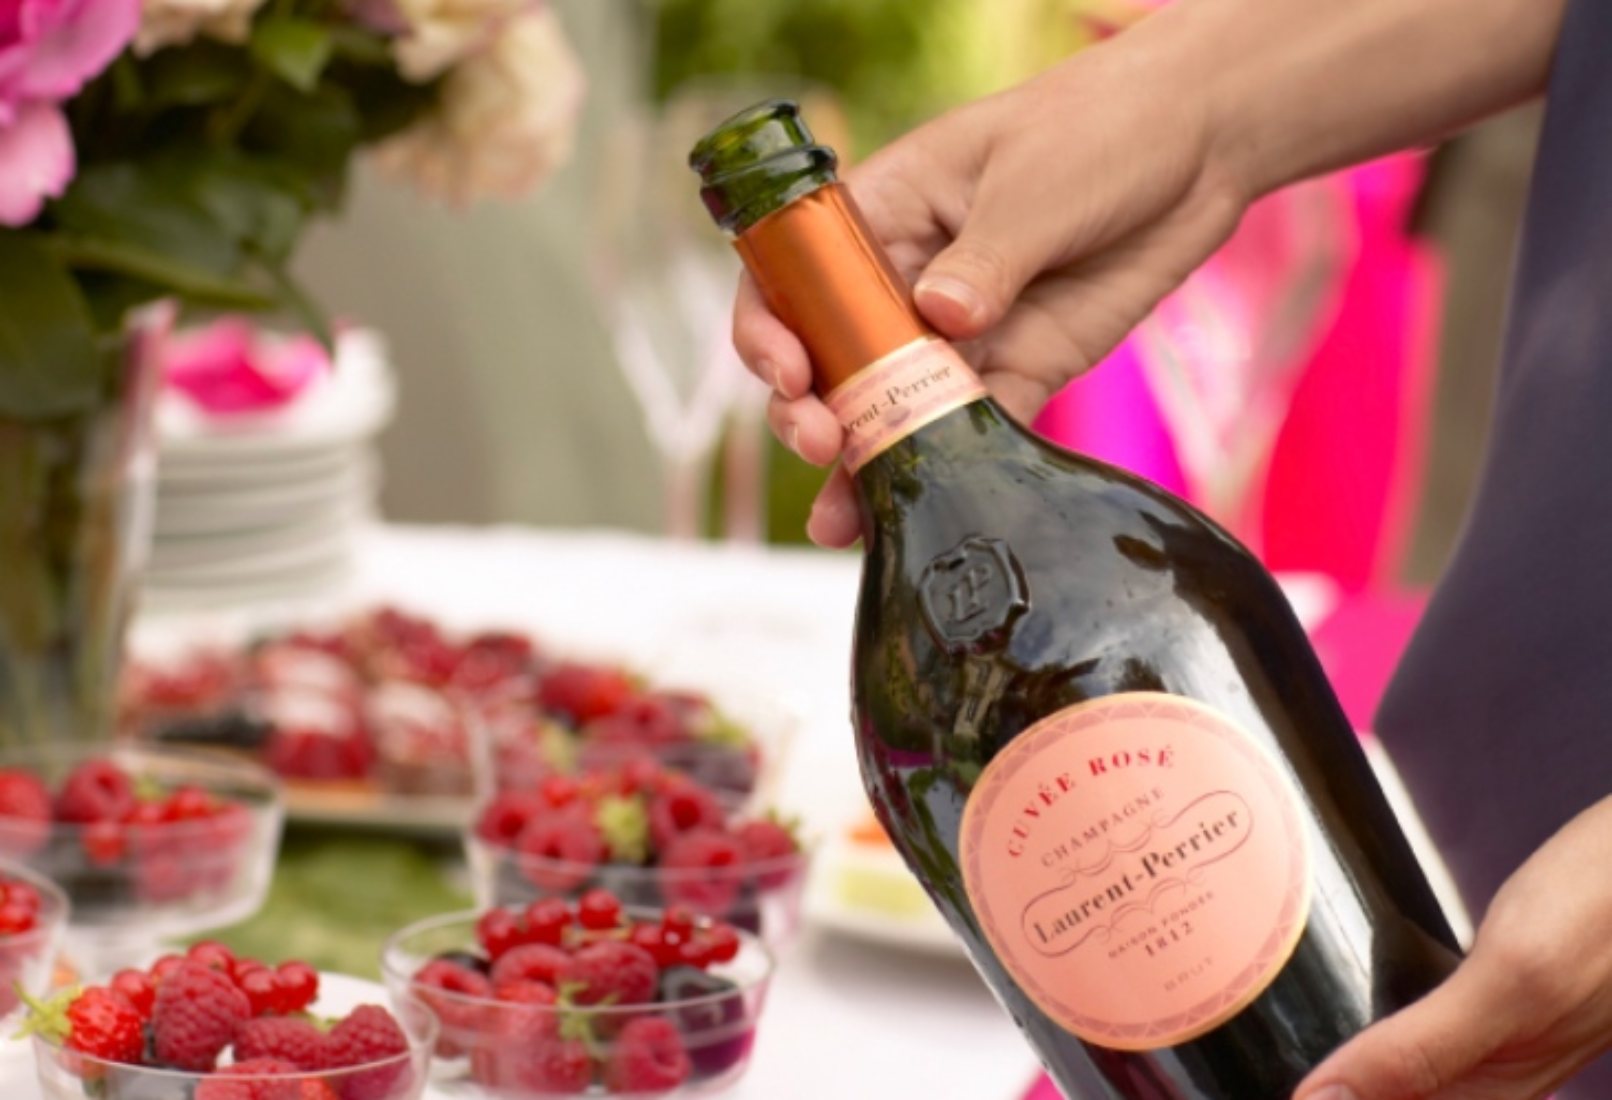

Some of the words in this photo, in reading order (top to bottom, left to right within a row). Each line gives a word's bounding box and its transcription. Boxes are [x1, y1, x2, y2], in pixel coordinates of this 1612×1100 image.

[845, 366, 951, 433] rent-Perrier
[1007, 773, 1076, 858] CUVÉE
[1088, 744, 1174, 776] ROSÉ
[1041, 788, 1163, 867] CHAMPAGNE
[1032, 809, 1239, 943] Laurent-Perrier
[1144, 921, 1193, 957] 1812
